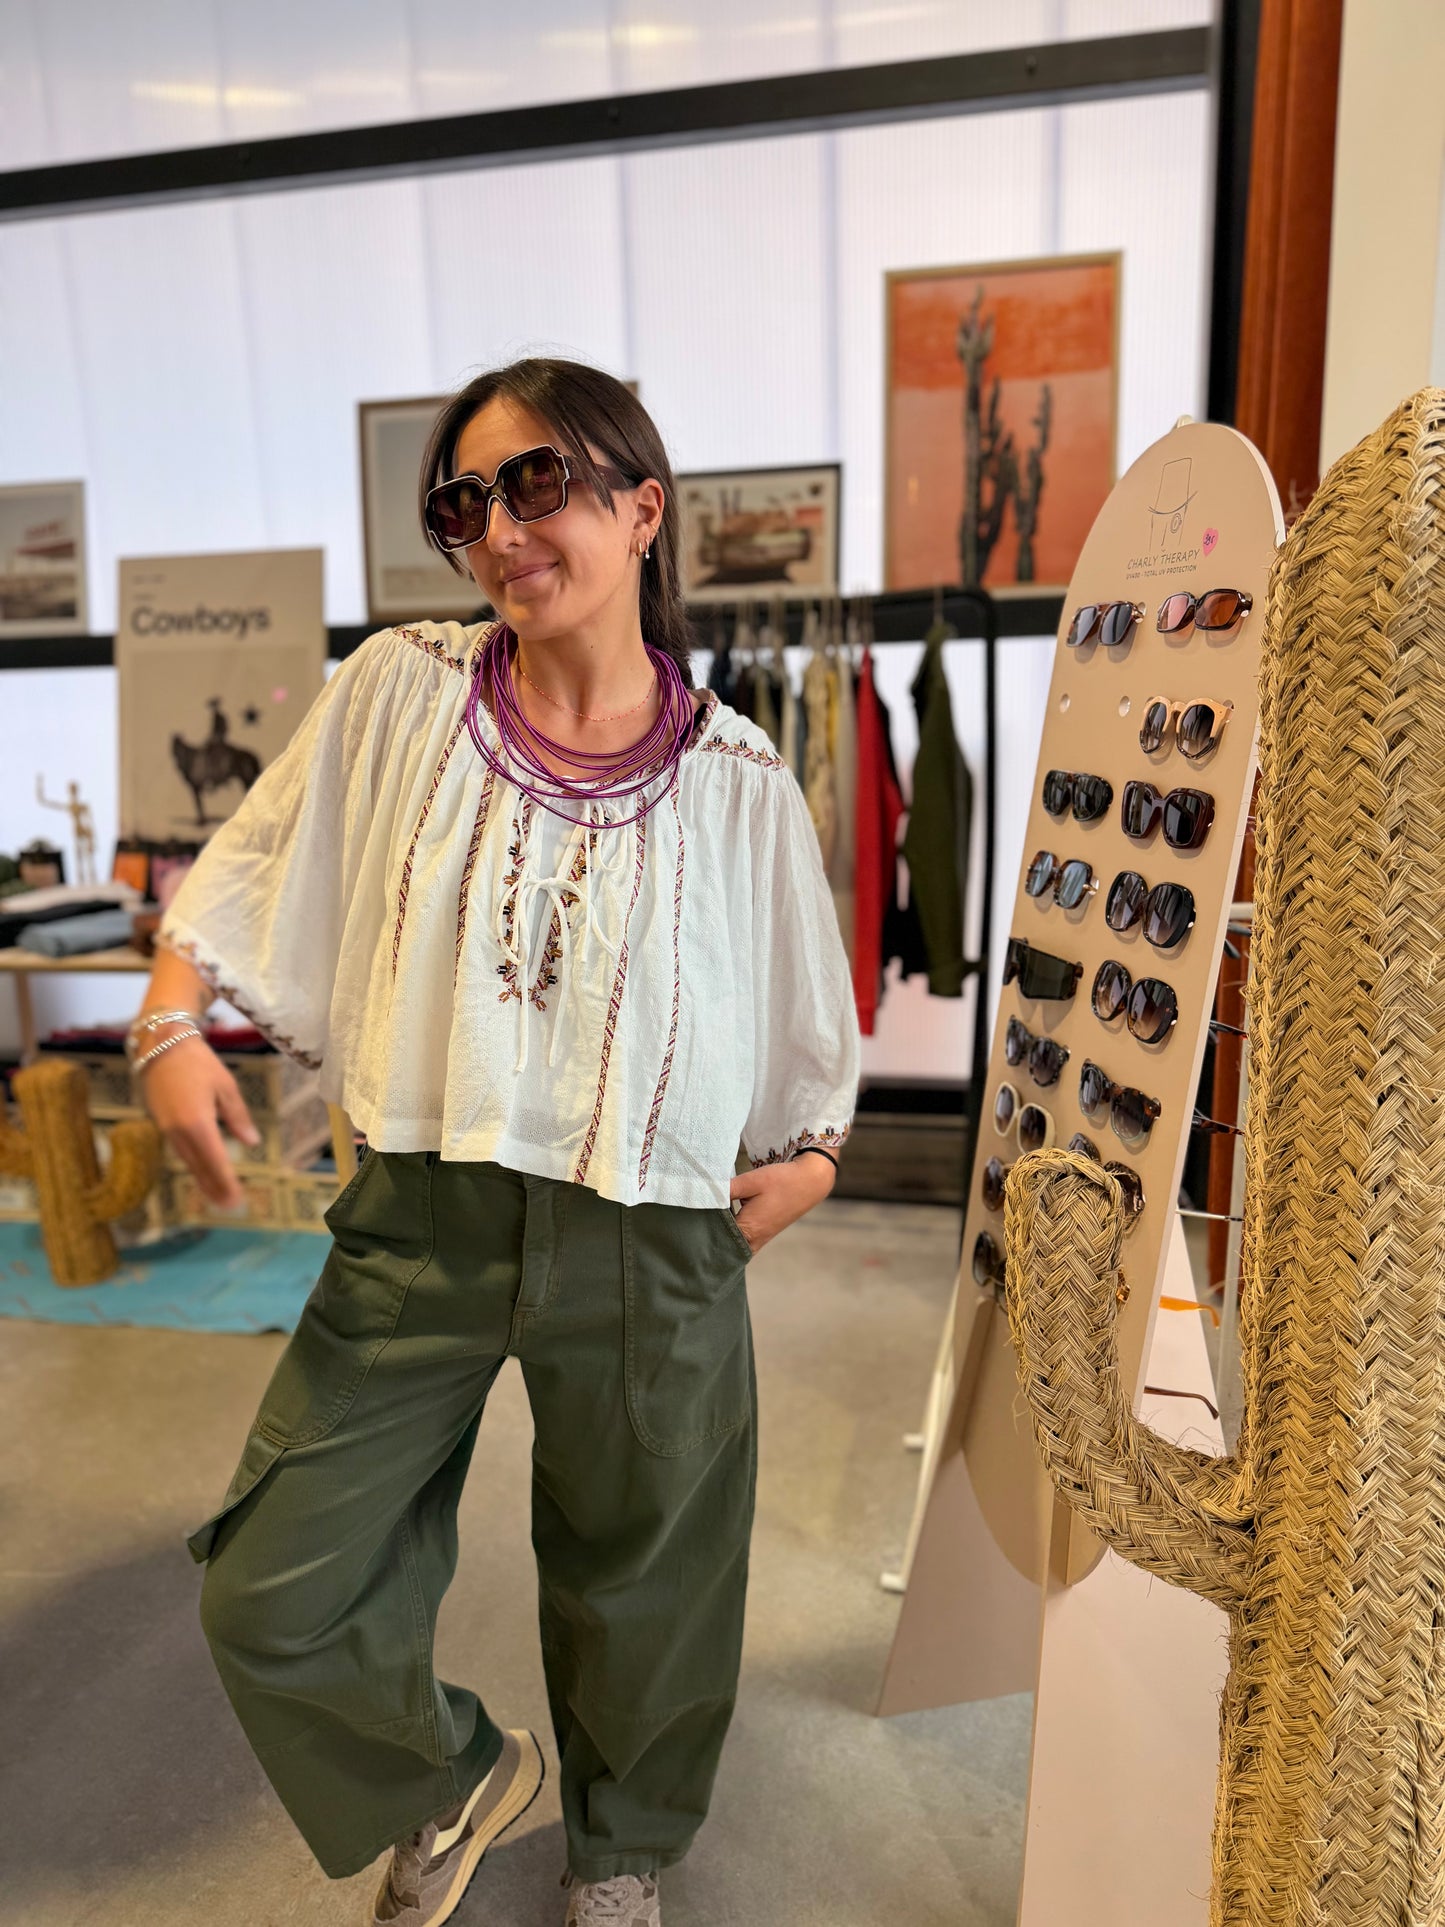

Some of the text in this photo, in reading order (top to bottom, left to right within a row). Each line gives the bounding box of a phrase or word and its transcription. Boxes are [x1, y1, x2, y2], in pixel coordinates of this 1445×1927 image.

[1127, 549, 1200, 570] CHARLY THERAPY
[1166, 564, 1197, 575] PROTECTION
[131, 604, 270, 640] Cowboys
